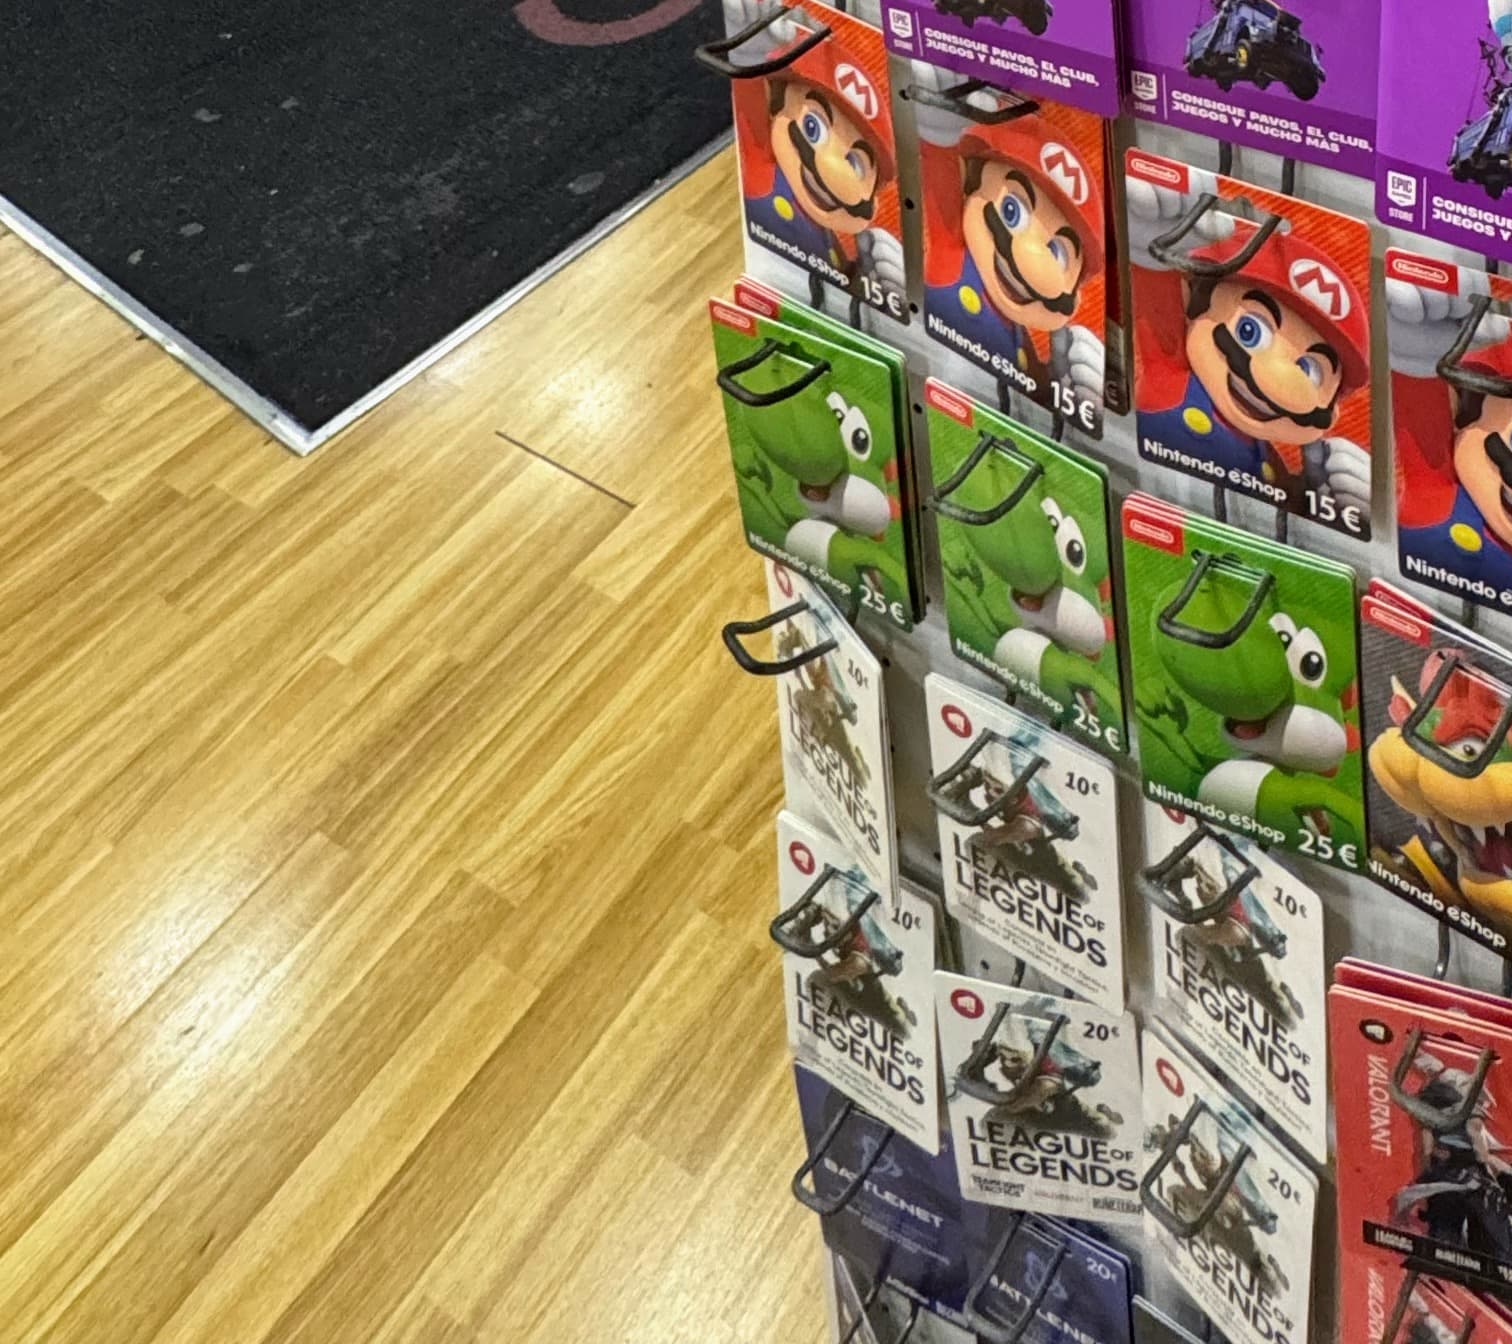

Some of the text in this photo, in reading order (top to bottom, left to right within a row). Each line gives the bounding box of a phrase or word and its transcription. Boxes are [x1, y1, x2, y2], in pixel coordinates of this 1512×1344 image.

[928, 315, 992, 364] Nintendo
[992, 353, 1038, 393] eShop
[1143, 438, 1226, 480] Nintendo
[1228, 466, 1287, 504] eShop
[1406, 556, 1497, 601] Nintendo
[1149, 781, 1227, 823] Nintendo
[1229, 812, 1286, 844] eShop
[953, 832, 1084, 929] LEAGUE
[955, 862, 1108, 969] LEGENDS
[1366, 1054, 1391, 1157] VALORANT
[967, 1115, 1133, 1163] LEAGUE OF
[971, 1143, 1138, 1192] LEGENDS
